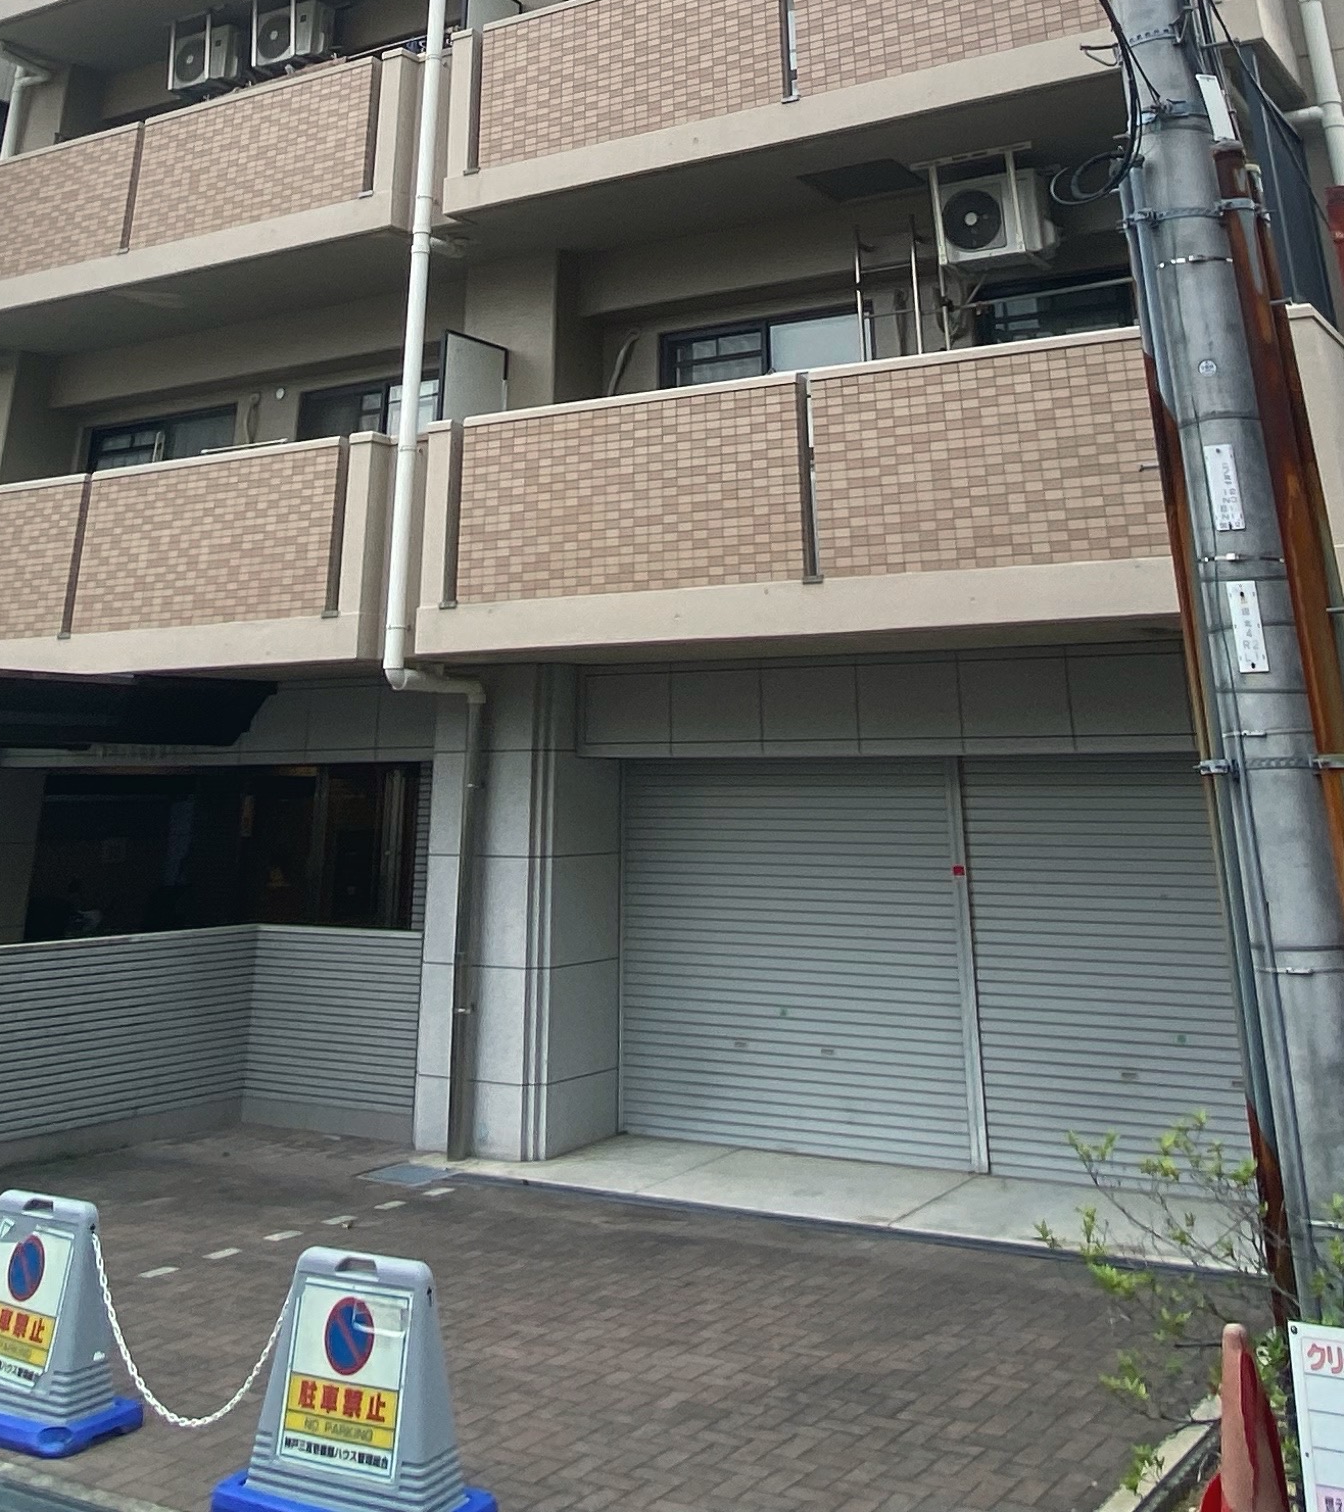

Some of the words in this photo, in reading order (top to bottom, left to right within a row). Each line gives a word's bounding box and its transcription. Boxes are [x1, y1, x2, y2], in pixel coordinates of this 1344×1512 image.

[298, 1380, 386, 1423] 駐車禁止
[324, 1420, 374, 1442] PARKING
